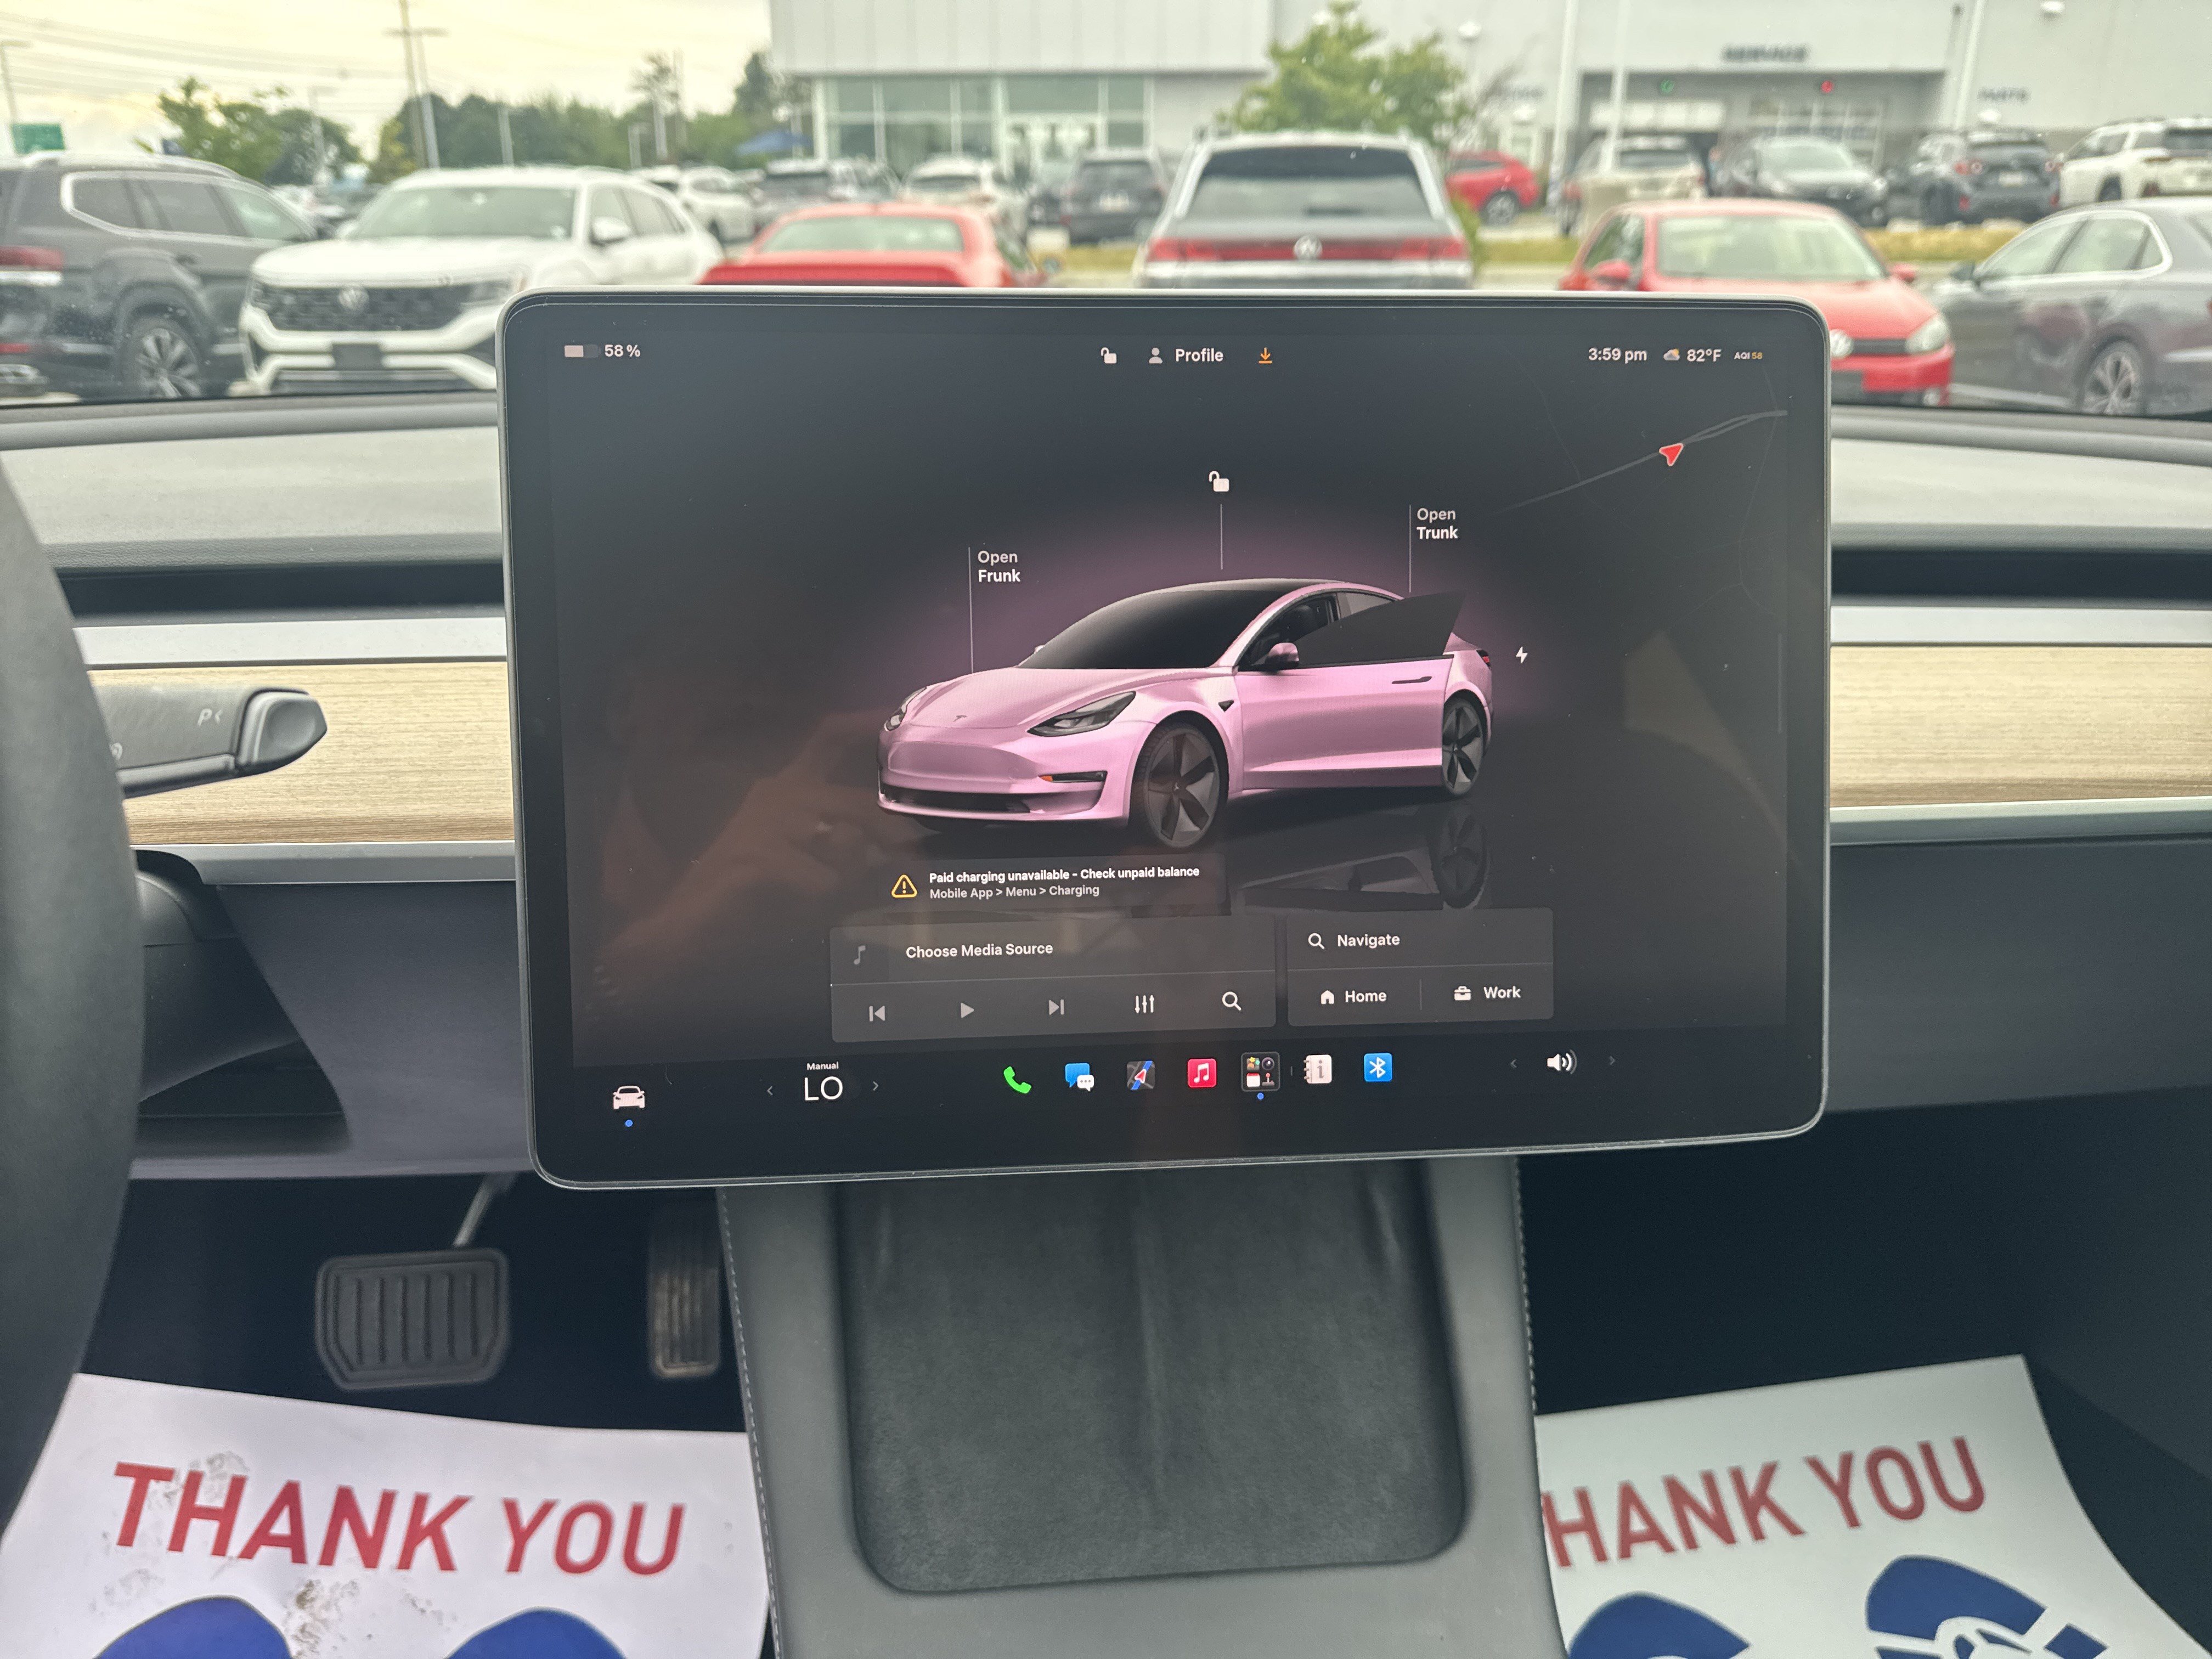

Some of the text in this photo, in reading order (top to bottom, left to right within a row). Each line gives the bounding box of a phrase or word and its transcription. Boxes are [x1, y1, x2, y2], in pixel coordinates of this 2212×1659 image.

[1175, 347, 1223, 362] Profile
[1588, 347, 1647, 364] 3:59 pm
[1686, 348, 1722, 362] 82°F
[1734, 352, 1763, 360] AQI 58
[1417, 507, 1456, 523] Open
[1416, 525, 1458, 539] Trunk
[978, 550, 1018, 566] Open
[978, 568, 1021, 583] Frunk
[929, 872, 954, 883] Paid
[956, 871, 1006, 884] charging
[1007, 868, 1070, 881] unavailable
[1080, 867, 1116, 879] Check
[1118, 866, 1155, 881] unpaid
[1157, 866, 1200, 877] balance
[930, 888, 968, 899] Mobile
[970, 888, 994, 900] App
[1006, 887, 1036, 897] Menu
[1049, 884, 1099, 898] Charging
[1338, 934, 1400, 949] Navigate
[906, 943, 1053, 958] Choose Media Source
[1345, 990, 1387, 1003] Home
[1483, 985, 1521, 999] Work
[806, 1061, 839, 1070] Manual
[804, 1076, 843, 1101] LO
[1541, 1435, 1985, 1569] HANK YOU
[114, 1462, 684, 1576] THANK YOU
